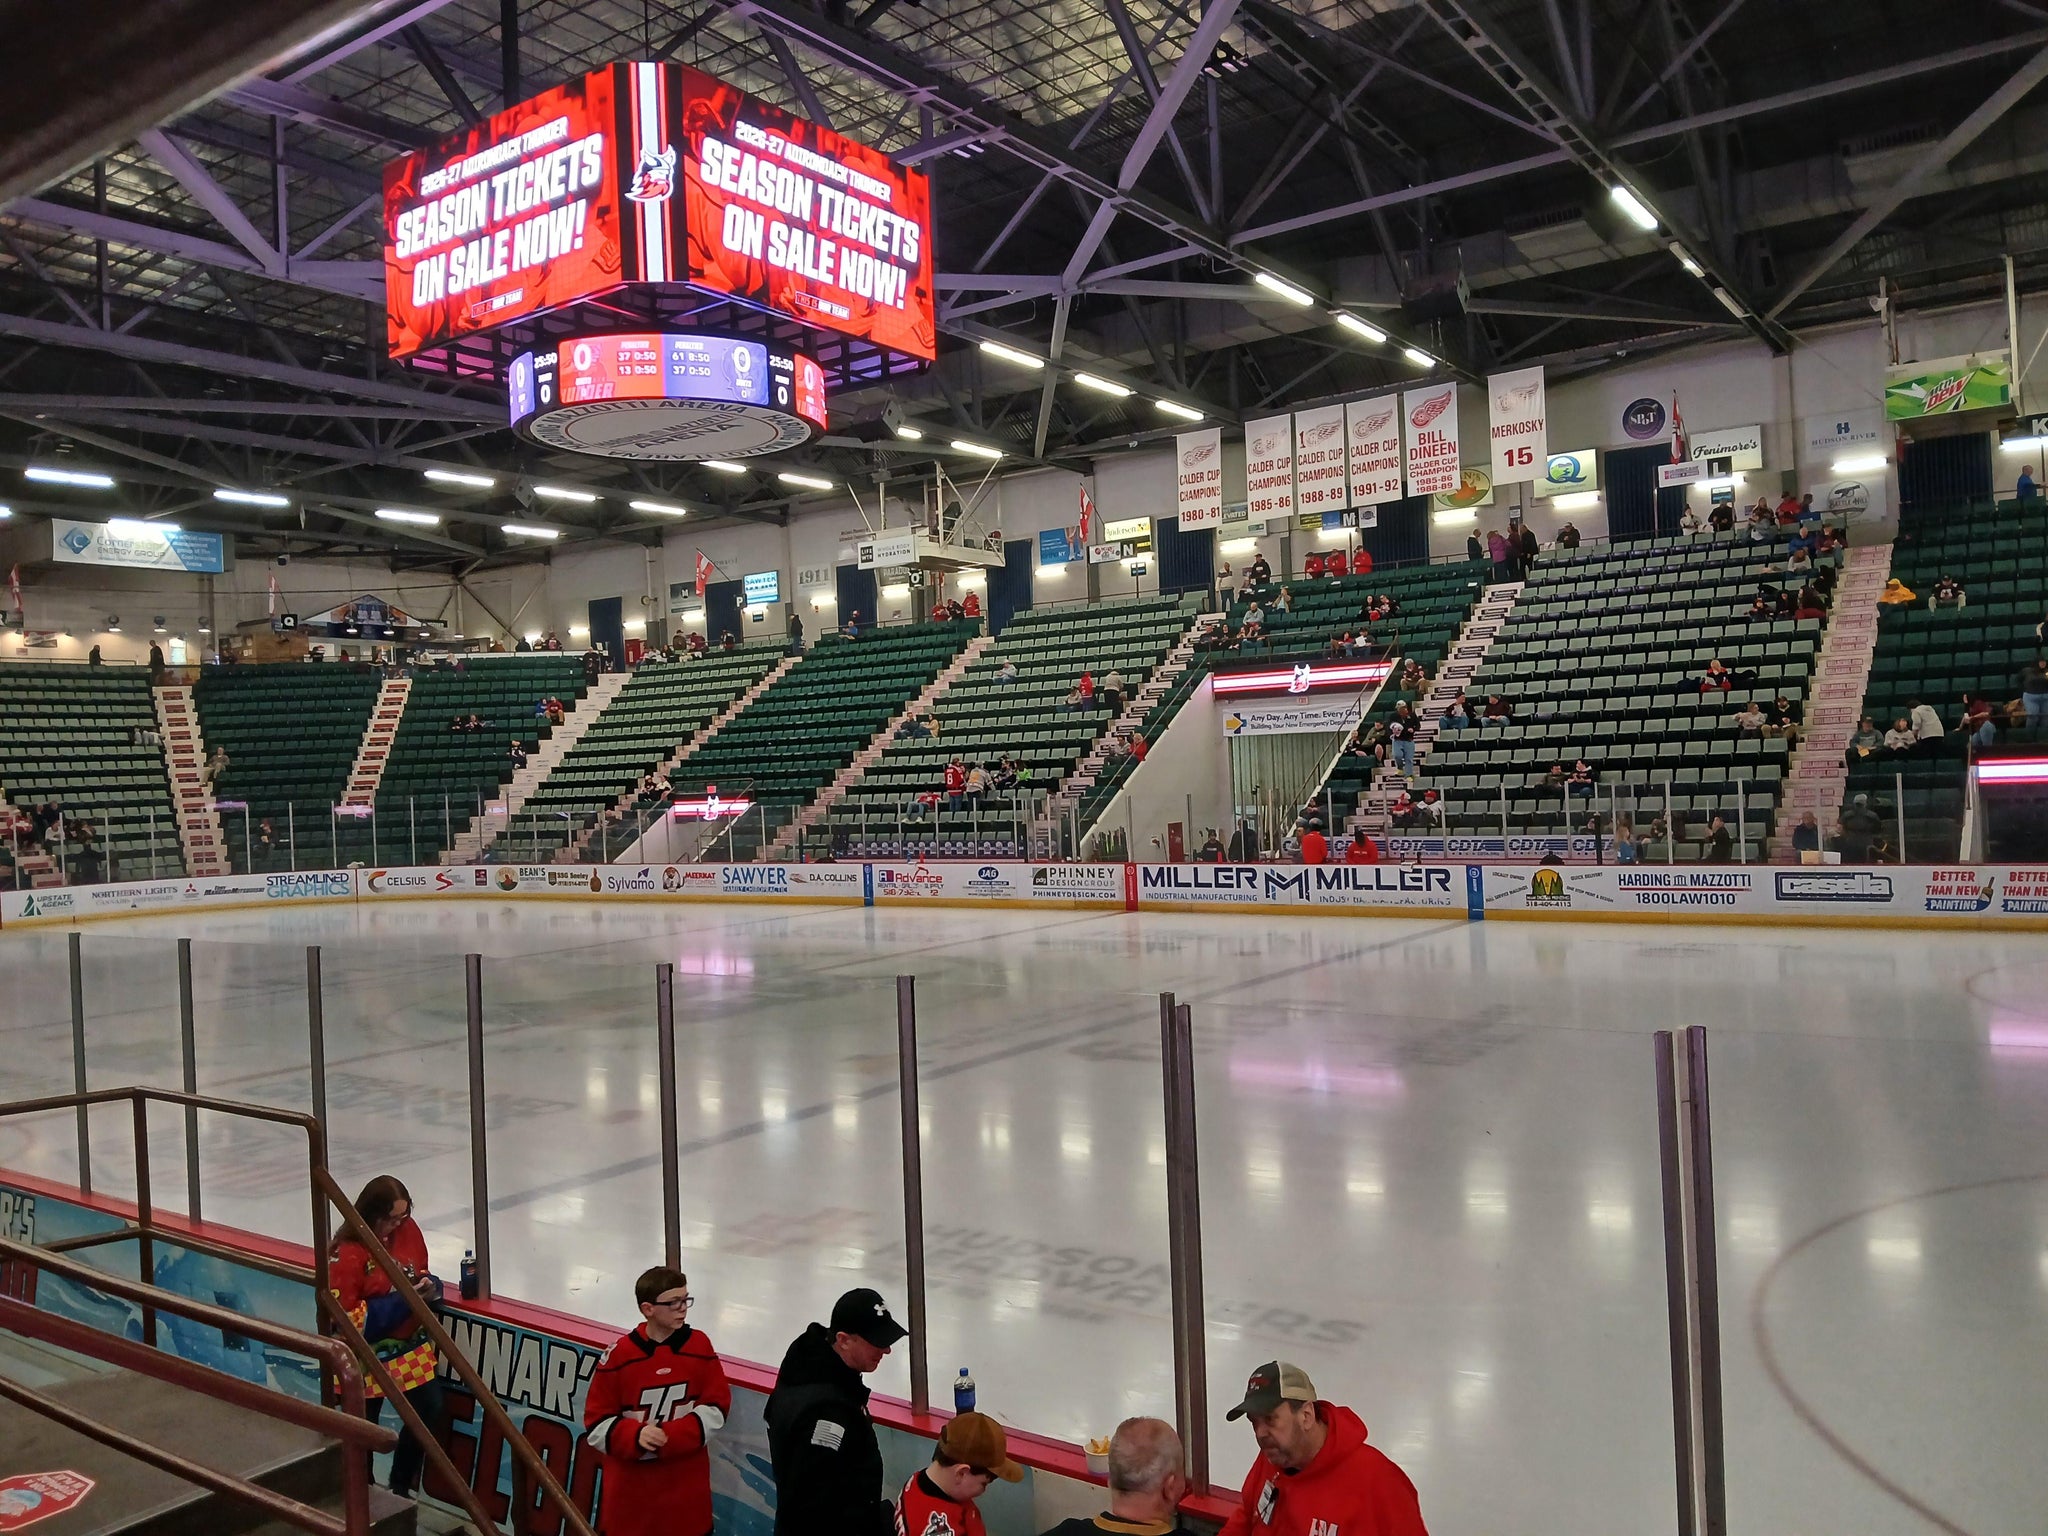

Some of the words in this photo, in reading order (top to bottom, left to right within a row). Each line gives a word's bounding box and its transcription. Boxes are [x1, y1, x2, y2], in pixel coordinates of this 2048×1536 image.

[462, 136, 522, 178] ADIRONDACK
[522, 116, 568, 154] THUNDER
[784, 143, 848, 186] ADIRONDACK
[848, 169, 891, 202] THUNDER
[396, 180, 489, 258] SEASON
[492, 133, 603, 221] TICKETS
[700, 136, 814, 222] SEASON
[817, 183, 919, 263] TICKETS
[412, 252, 446, 308] ON
[448, 228, 510, 295] SALE
[512, 199, 587, 271] NOW!
[722, 203, 765, 260] ON
[768, 220, 836, 285] SALE
[839, 246, 907, 310] NOW!
[534, 352, 557, 369] 25:50
[573, 343, 593, 371] 0
[618, 352, 631, 362] 37
[634, 352, 656, 361] 0:50
[672, 352, 684, 361] 61
[688, 352, 710, 362] 8:50
[733, 346, 751, 373] 0
[769, 355, 793, 372] 25:50
[619, 366, 632, 375] 13
[634, 365, 657, 374] 0:50
[673, 365, 686, 375] 37
[689, 366, 711, 376] 0:50
[540, 384, 551, 404] 0
[777, 386, 788, 405] 0
[658, 400, 748, 414] ARENA
[1492, 419, 1544, 440] MERKOSKY
[2032, 418, 2048, 436] K
[633, 421, 746, 449] ARENA
[1418, 429, 1446, 446] BILL
[1812, 436, 1847, 446] HUDSON
[1850, 432, 1876, 440] RIVER
[1350, 441, 1380, 458] CALDER
[1382, 438, 1398, 453] CUP
[1409, 441, 1457, 461] DINEEN
[1693, 440, 1758, 458] Fenimore's
[1298, 450, 1325, 466] CALDER
[1328, 447, 1343, 462] CUP
[1409, 459, 1440, 471] CALDER
[1441, 456, 1458, 466] CUP
[1504, 446, 1533, 467] 15
[1247, 459, 1274, 475] CALDER
[1277, 456, 1291, 470] CUP
[1351, 456, 1399, 476] CHAMPIONS
[1410, 465, 1458, 479] CHAMPION
[1713, 462, 1726, 477] L
[1180, 471, 1204, 485] CALDER
[1207, 468, 1220, 481] CUP
[1298, 465, 1344, 483] CHAMPIONS
[1416, 474, 1453, 487] 1985-86
[1248, 474, 1292, 492] CHAMPIONS
[1353, 478, 1399, 497] 1991-92
[1416, 482, 1453, 494] 1988-89
[1180, 486, 1220, 502] CHAMPIONS
[1300, 487, 1343, 504] 1988-89
[1250, 496, 1291, 512] 1985-86
[1181, 506, 1220, 522] 1980-81
[97, 547, 132, 559] ENERGY
[134, 549, 166, 558] GROUP
[877, 549, 911, 558] HYDRATION
[1123, 544, 1134, 556] N
[800, 568, 829, 585] 1911
[736, 597, 744, 607] P
[284, 616, 294, 627] Q
[1266, 713, 1282, 722] Day.
[1284, 713, 1298, 721] Any
[1300, 711, 1321, 719] Time.
[1322, 711, 1343, 719] Every
[1272, 721, 1285, 729] Your
[1448, 839, 1487, 850] CDTA
[1508, 839, 1549, 850] CDTA
[267, 872, 349, 886] STREAMLINED
[519, 867, 545, 876] BEAN'S
[685, 872, 715, 880] MEERKAT
[722, 867, 787, 884] SAWYER
[809, 873, 823, 881] D.A.
[824, 873, 857, 882] COLLINS
[895, 873, 942, 883] Advance
[980, 870, 997, 878] JAG
[1050, 867, 1115, 878] PHINNEY
[1143, 866, 1257, 889] MILLER
[1932, 871, 1976, 881] BETTER
[387, 877, 426, 886] CELSIUS
[608, 877, 655, 892] Sylvamo
[1317, 867, 1451, 892] MILLER
[1618, 874, 1671, 887] HARDING
[1690, 874, 1752, 887] MAZZOTTI
[37, 893, 72, 903] UPSTATE
[92, 888, 142, 899] NORTHERN
[145, 886, 178, 895] LIGHTS
[267, 883, 349, 898] GRAPHICS
[1146, 892, 1189, 900] INDUSTRIAL
[1190, 893, 1258, 902] MANUFACTURING
[1495, 891, 1509, 901] SERVICE
[1926, 885, 1953, 895] THAN
[1956, 886, 1981, 896] NEW
[2003, 886, 2031, 896] THAN
[42, 900, 74, 908] AGENCY
[1636, 893, 1736, 905] 1800LAW1010
[1930, 900, 1977, 910] PAINTING
